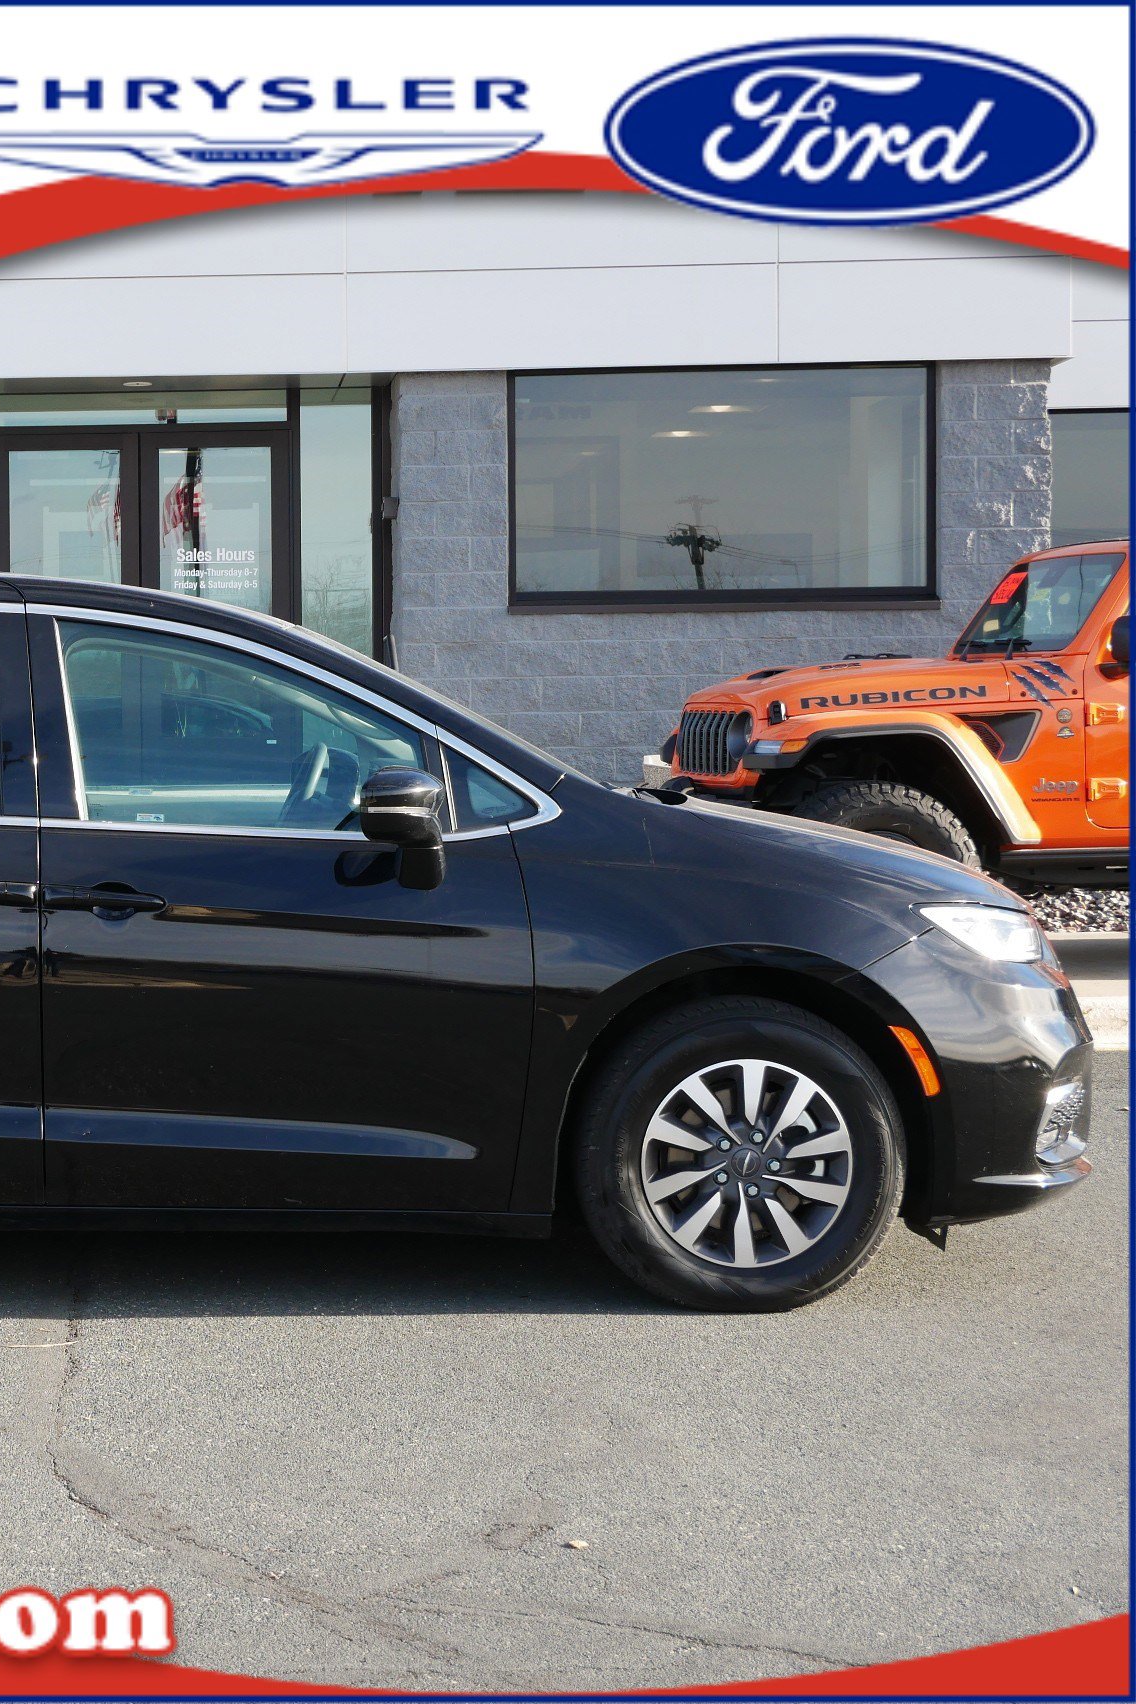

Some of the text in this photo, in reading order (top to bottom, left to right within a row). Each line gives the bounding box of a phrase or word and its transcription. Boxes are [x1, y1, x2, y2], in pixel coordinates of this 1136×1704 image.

[176, 547, 255, 562] Sales Hours
[174, 568, 243, 579] Monday-Thursday
[174, 580, 198, 591] Friday
[199, 581, 206, 589] &
[207, 580, 242, 590] Saturday
[799, 685, 987, 710] RUBICON
[1032, 777, 1079, 795] Jeep
